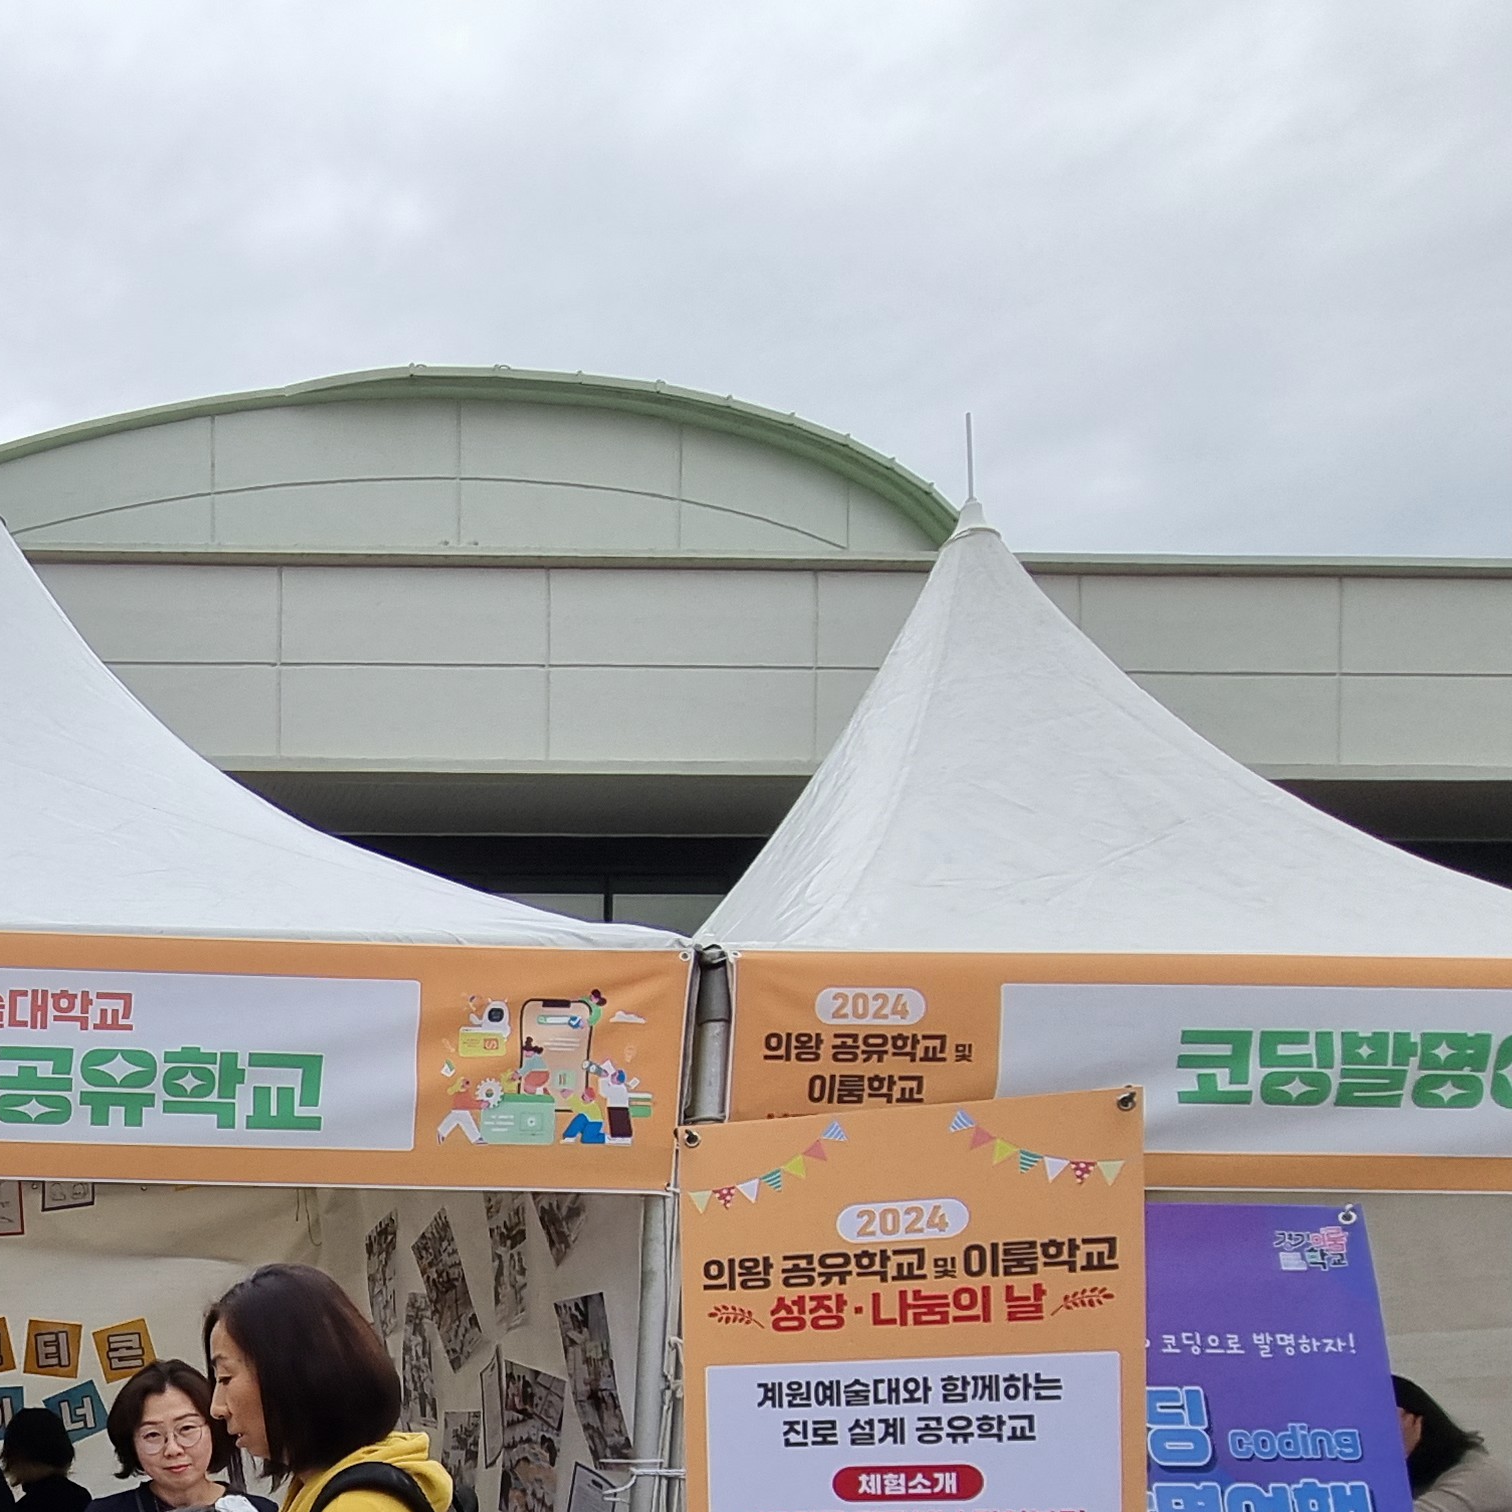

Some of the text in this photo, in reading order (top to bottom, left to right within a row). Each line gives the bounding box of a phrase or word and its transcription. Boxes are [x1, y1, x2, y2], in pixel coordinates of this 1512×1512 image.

[831, 992, 911, 1021] 2024
[763, 1033, 973, 1065] 의왕 공유학교 및
[808, 1074, 924, 1104] 이룸학교
[856, 1203, 949, 1238] 2024
[702, 1236, 1119, 1291] 의왕 공유학교 및 이룸학교
[1005, 1282, 1047, 1323] 날
[1162, 1332, 1357, 1358] 코딩으로 발명하자!
[757, 1372, 1063, 1410] 계원예술대와 함께하는
[782, 1414, 1037, 1448] 진로 설계 공유학교
[1229, 1423, 1362, 1460] coding
[857, 1472, 958, 1497] 체험소개
